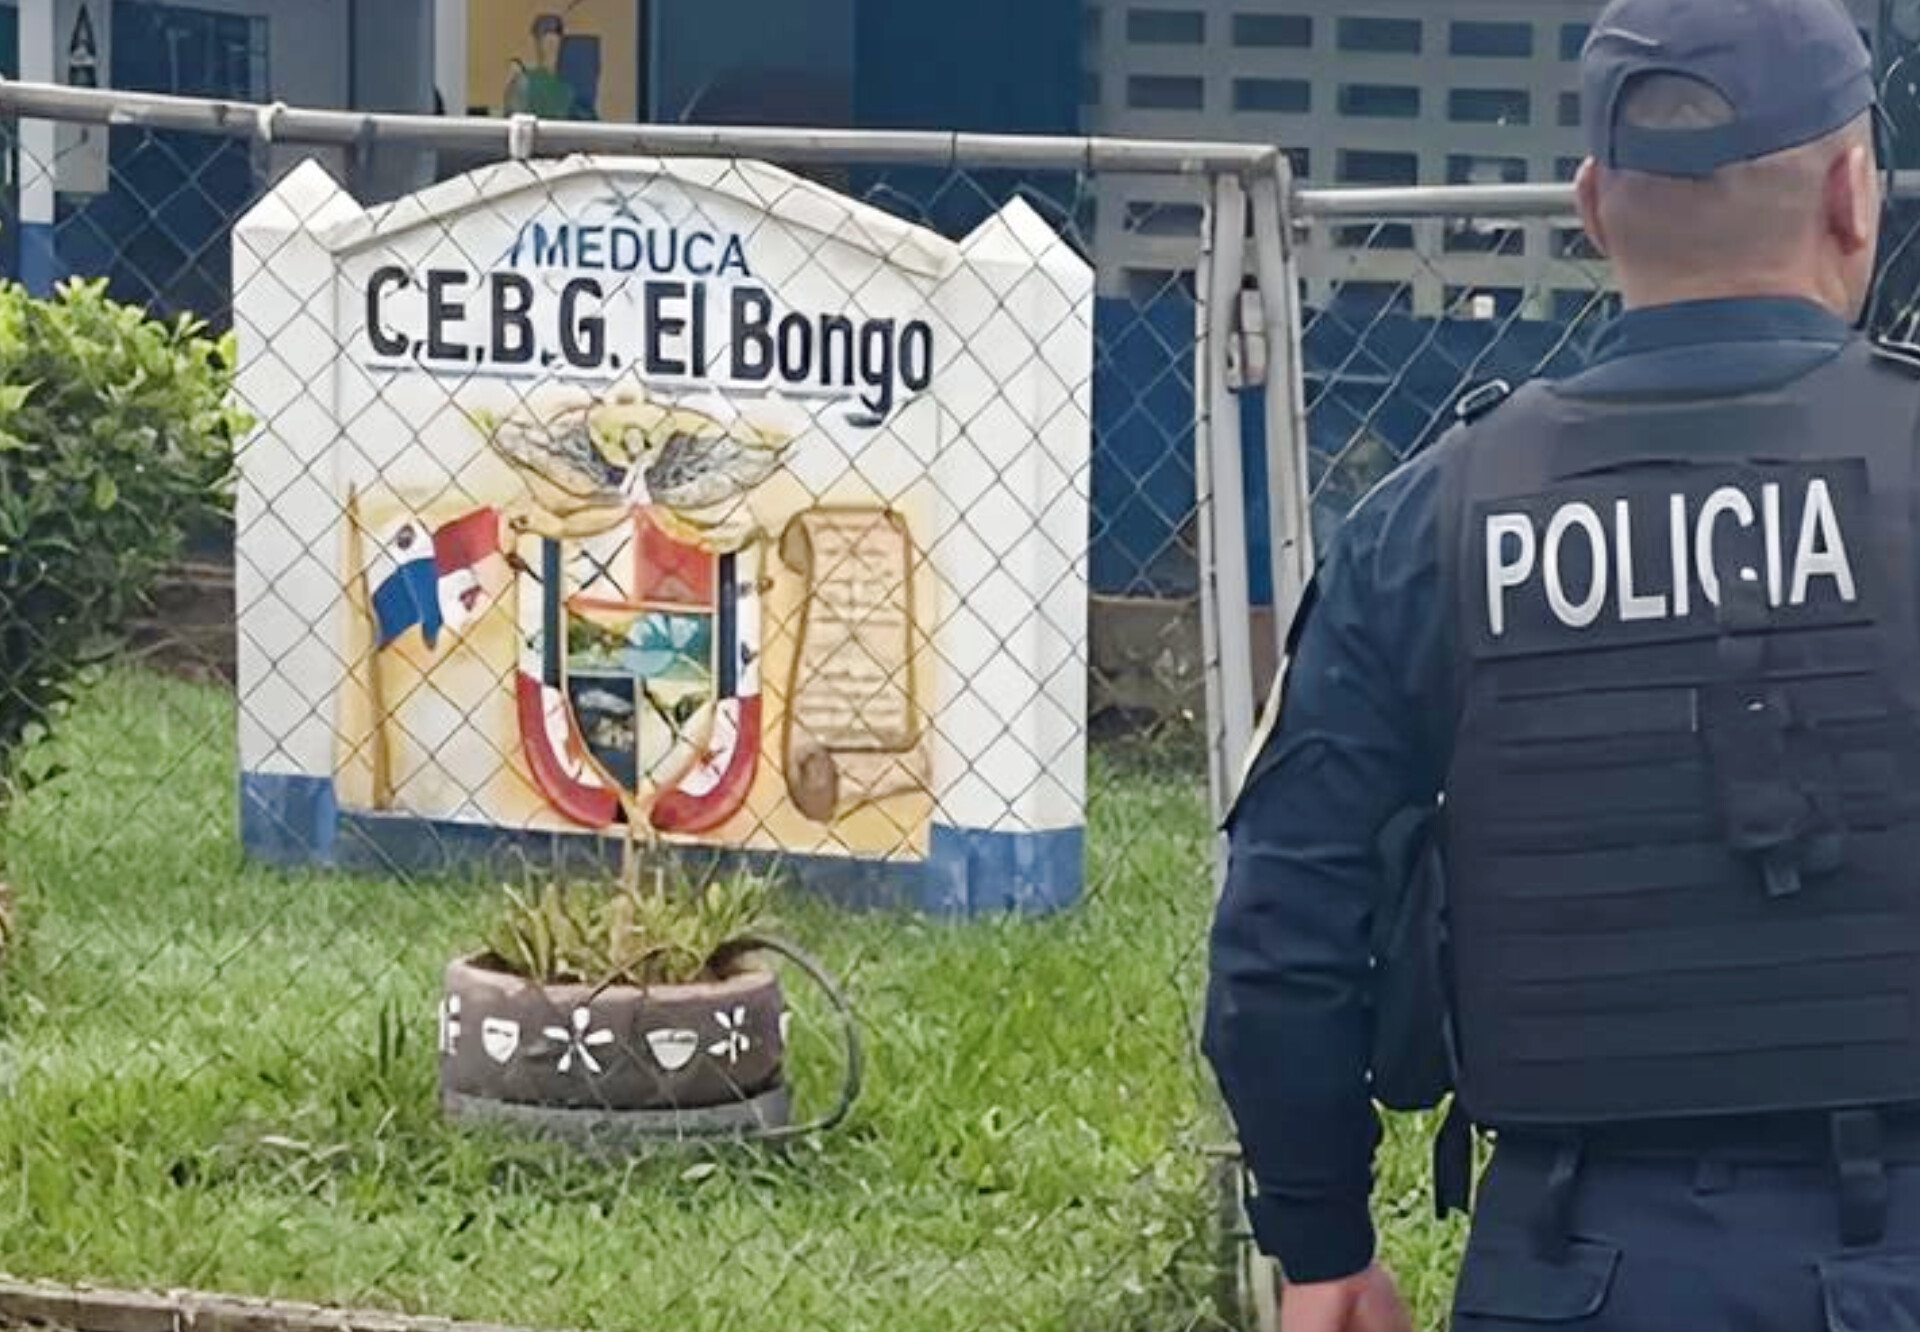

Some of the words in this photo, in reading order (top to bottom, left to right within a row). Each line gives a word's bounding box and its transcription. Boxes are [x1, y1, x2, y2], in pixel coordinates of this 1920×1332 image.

[511, 223, 750, 277] MEDUCA
[367, 266, 620, 370] C.E.B.G.
[644, 280, 706, 378] El
[730, 286, 933, 427] Bongo
[1486, 478, 1857, 635] POLICIA
